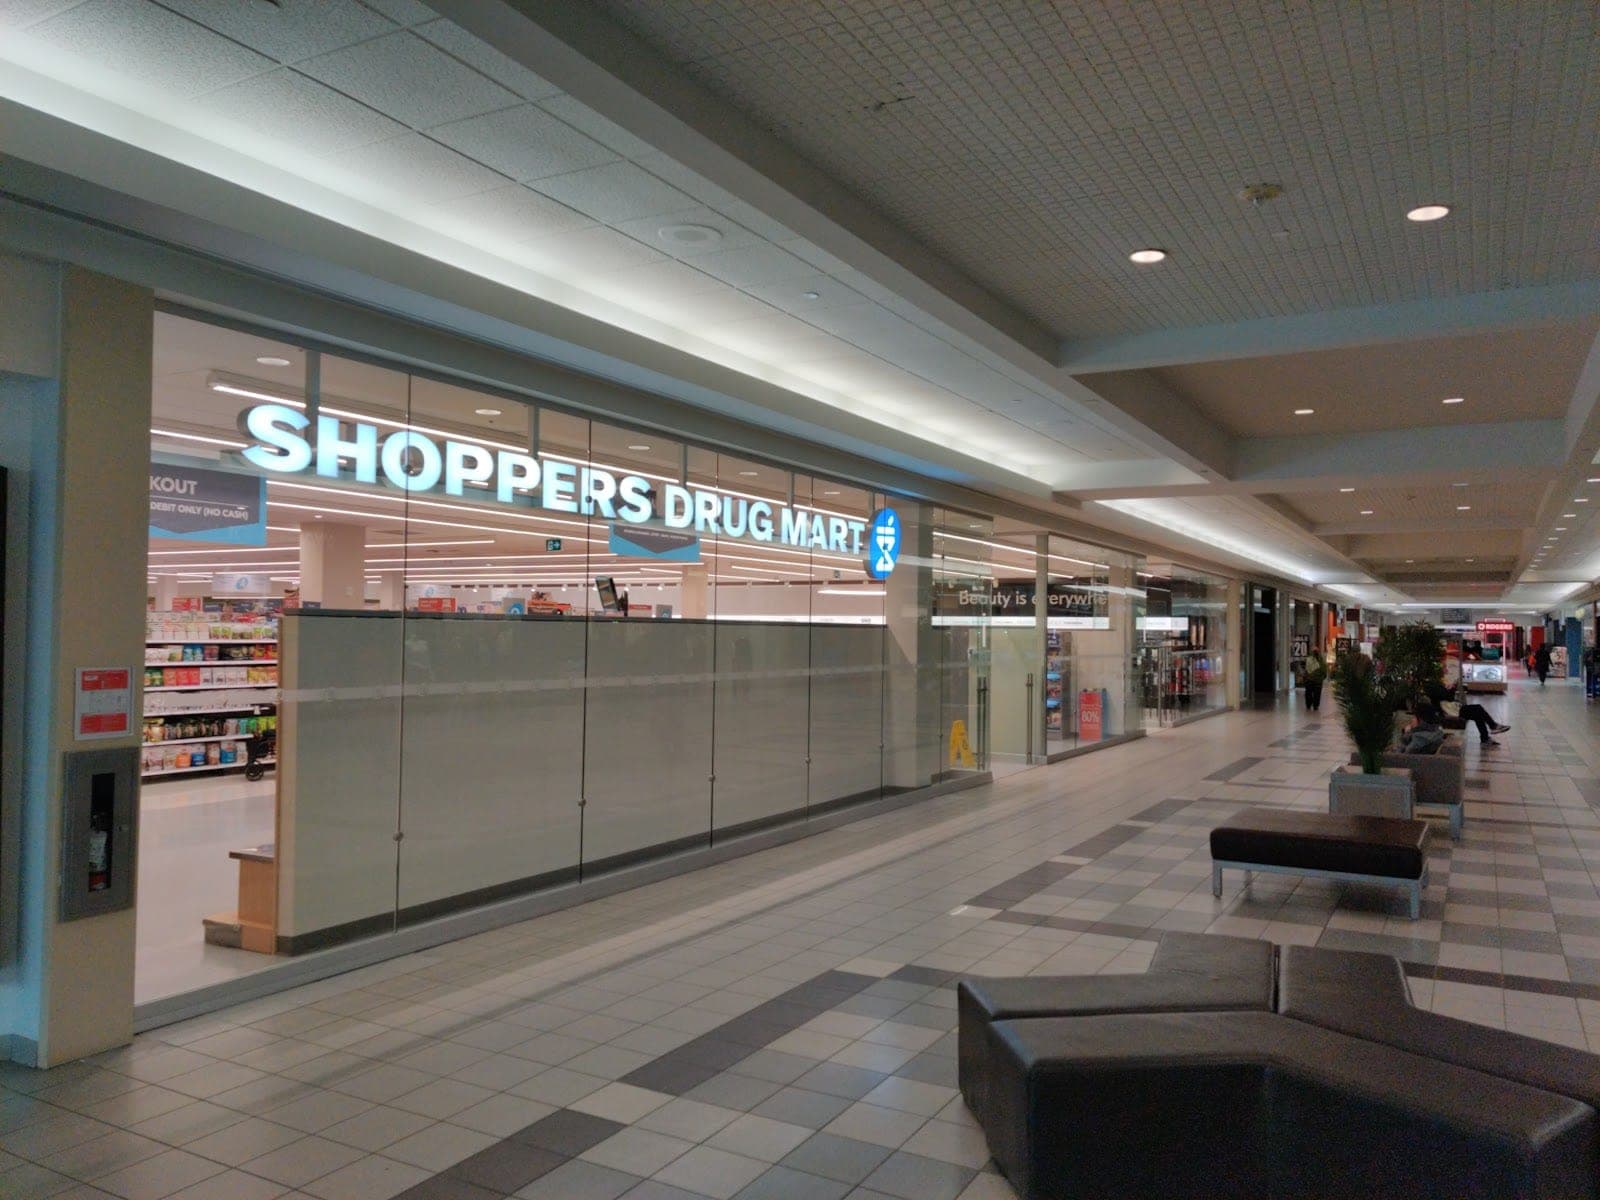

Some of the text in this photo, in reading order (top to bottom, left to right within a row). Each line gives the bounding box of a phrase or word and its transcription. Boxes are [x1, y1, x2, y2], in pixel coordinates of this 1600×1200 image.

[241, 403, 866, 555] SHOPPERS DRUG MART
[150, 501, 248, 521] DEBIT ONLY (NO CASH)
[959, 590, 1011, 609] Beauty
[1015, 590, 1028, 606] is
